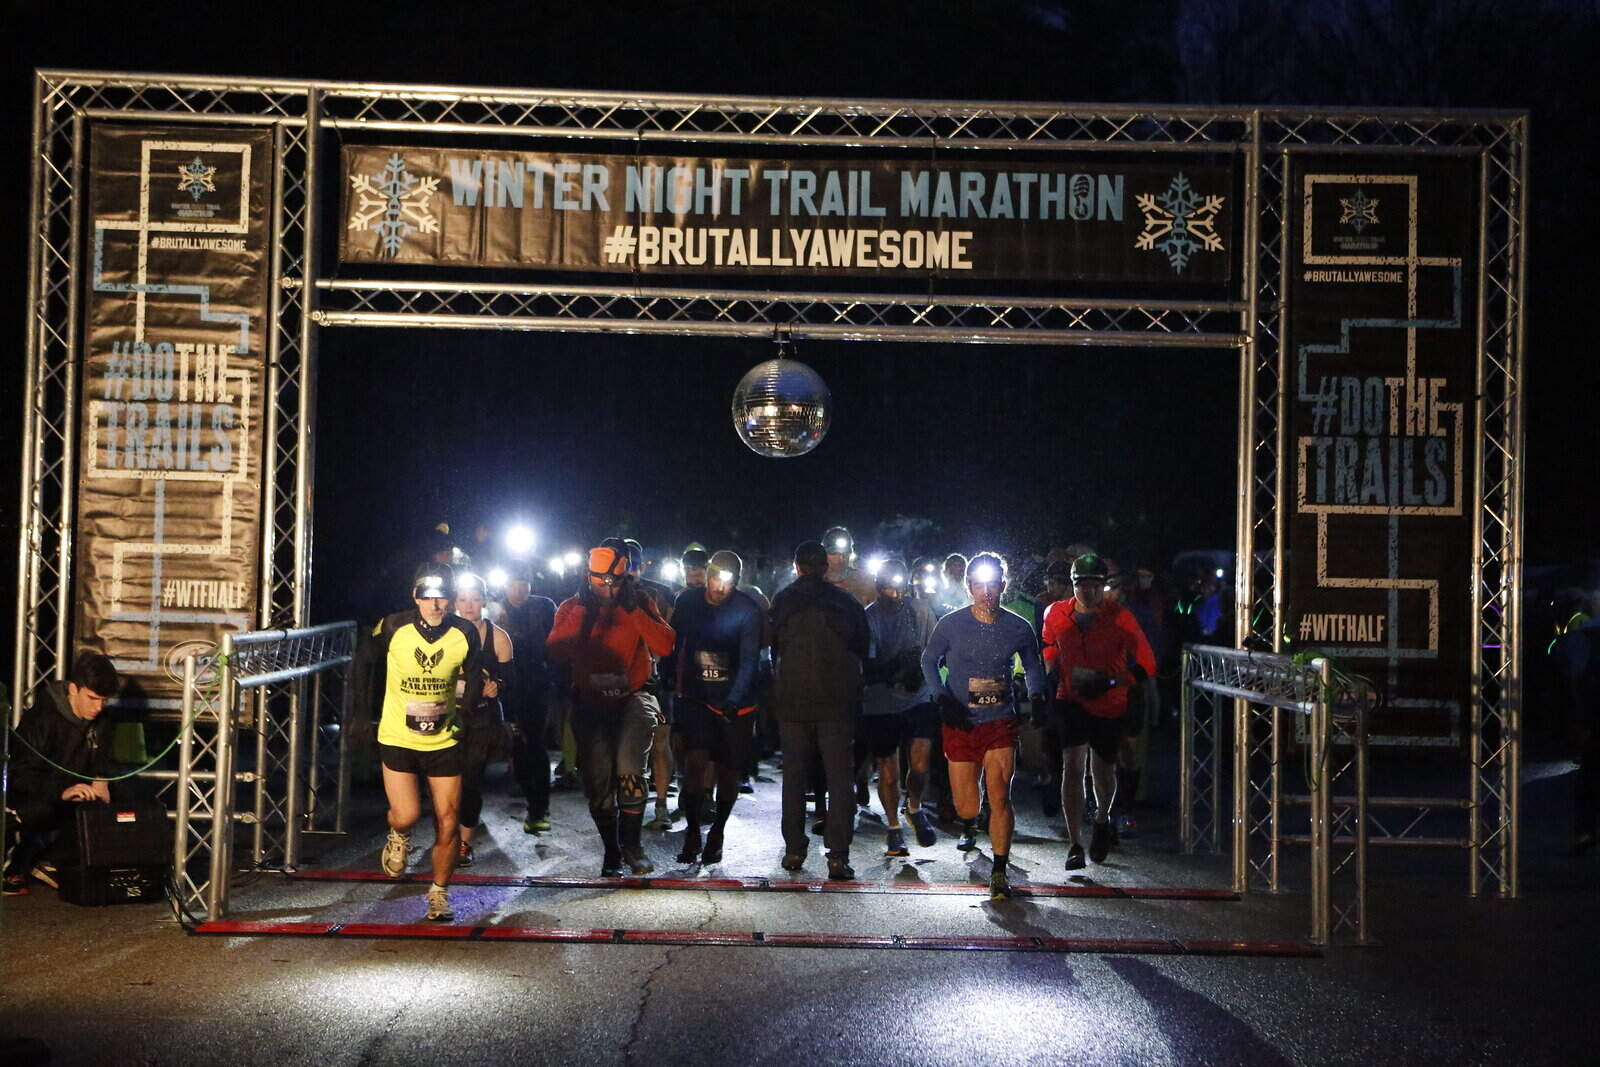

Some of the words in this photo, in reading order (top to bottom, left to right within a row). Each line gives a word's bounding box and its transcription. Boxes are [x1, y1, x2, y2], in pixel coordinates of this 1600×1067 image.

[449, 158, 611, 213] WINTER
[624, 166, 749, 217] NIGHT
[763, 169, 887, 218] TRAIL
[900, 170, 1125, 222] MARATHON
[151, 236, 247, 251] #BRUTALLYAWESOME
[603, 224, 974, 270] #BRUTALLYAWESOME
[1303, 270, 1404, 284] #BRUTALLYAWESOME
[101, 401, 235, 472] TRAILS
[1311, 436, 1448, 506] TRAILS
[162, 579, 247, 609] #WTFHALF
[1299, 613, 1386, 643] #WTFHALF
[701, 669, 720, 679] 415
[419, 721, 436, 732] 92
